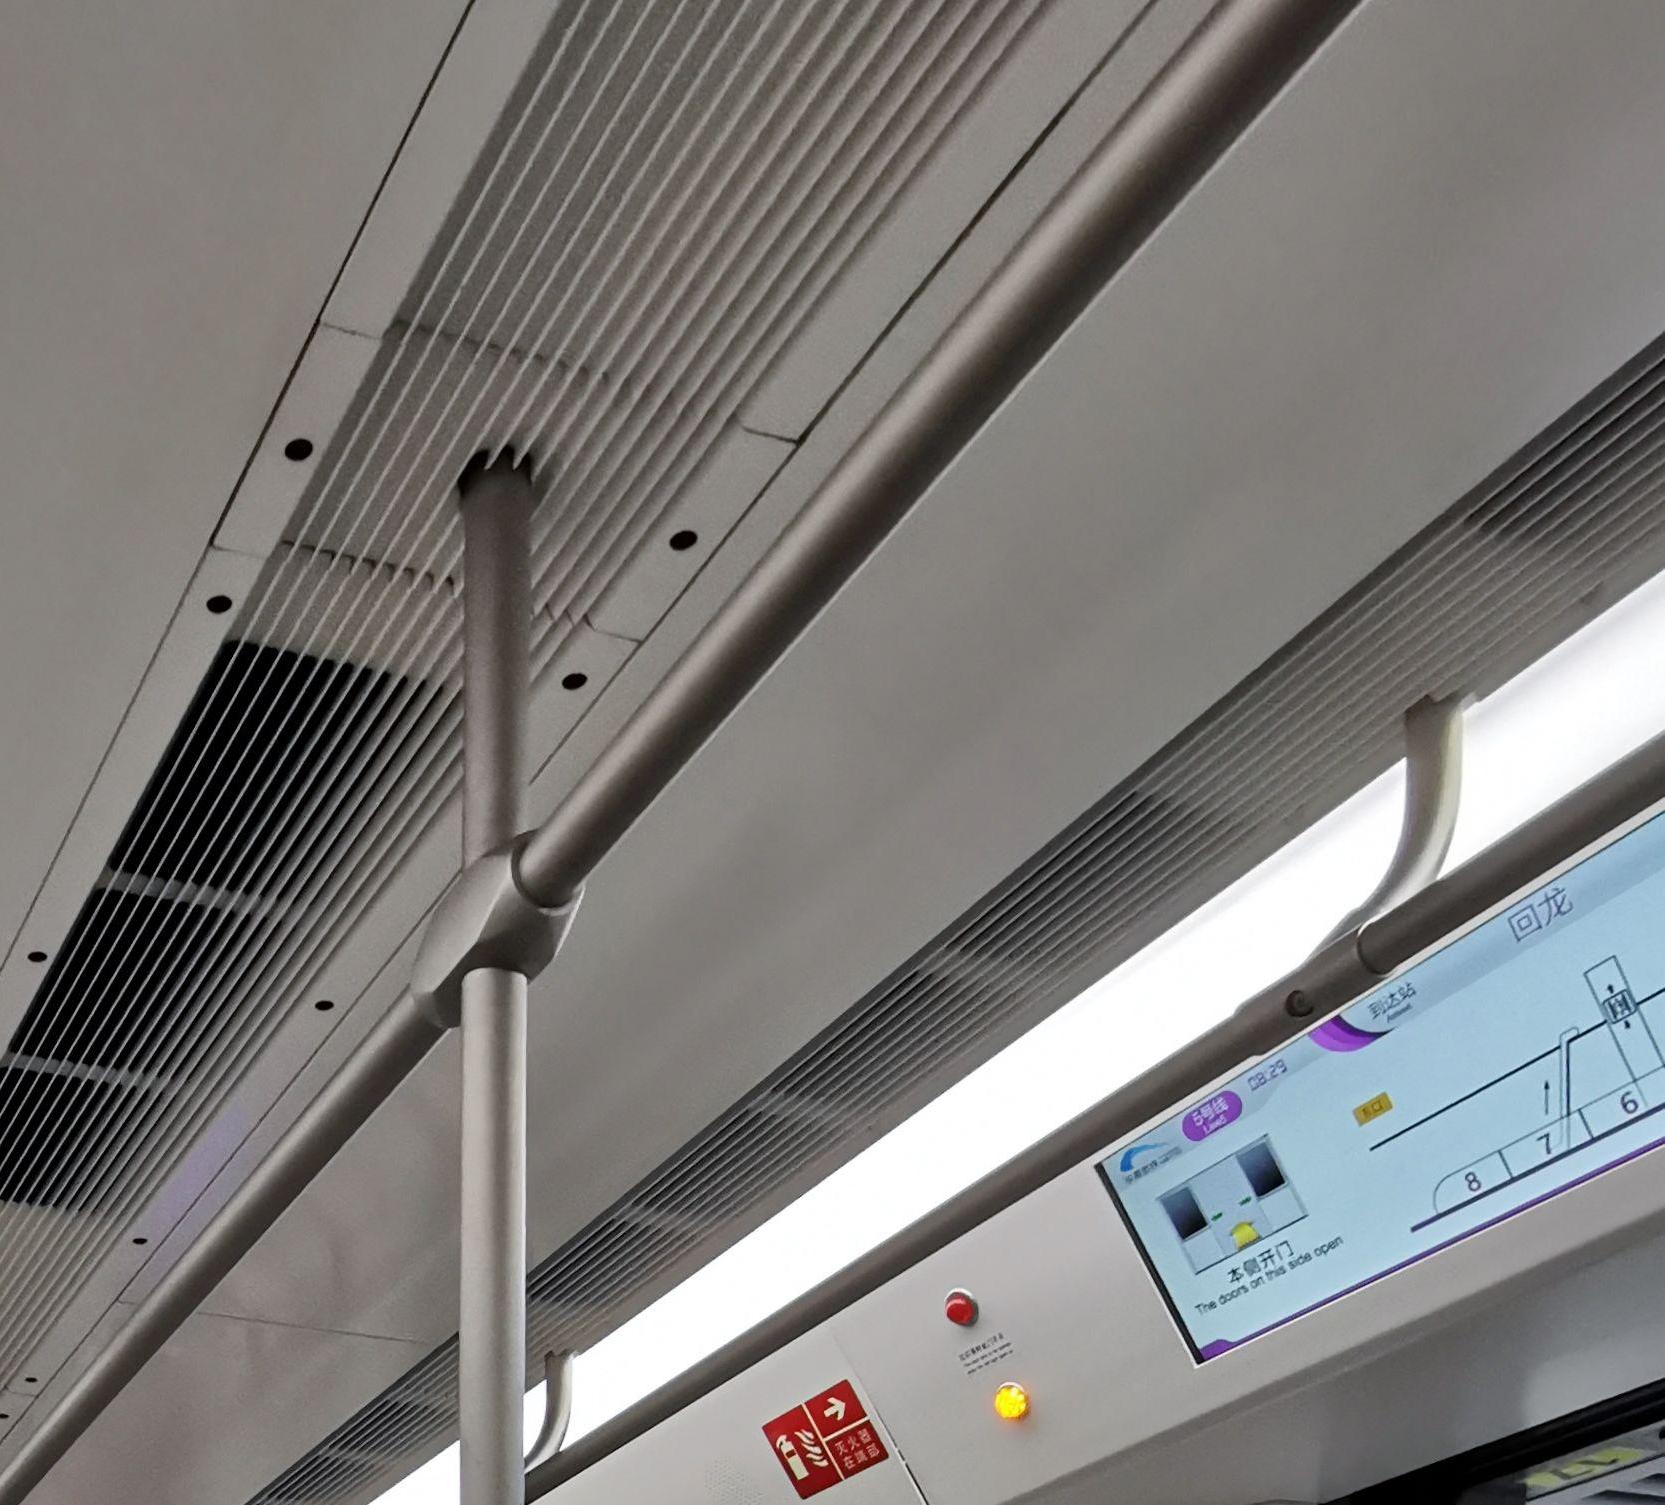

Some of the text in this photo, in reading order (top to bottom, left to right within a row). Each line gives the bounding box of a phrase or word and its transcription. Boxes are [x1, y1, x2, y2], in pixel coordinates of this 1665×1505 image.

[1508, 887, 1574, 942] 回龙
[1367, 982, 1417, 1020] 到达站
[1248, 1059, 1287, 1091] 08:29
[1620, 1092, 1639, 1114] 6
[1537, 1132, 1553, 1155] 7
[1465, 1172, 1482, 1192] 8
[1196, 1236, 1344, 1316] The doors on this side open
[1227, 1241, 1293, 1283] 本侧开门
[835, 1428, 871, 1455] 灭火器
